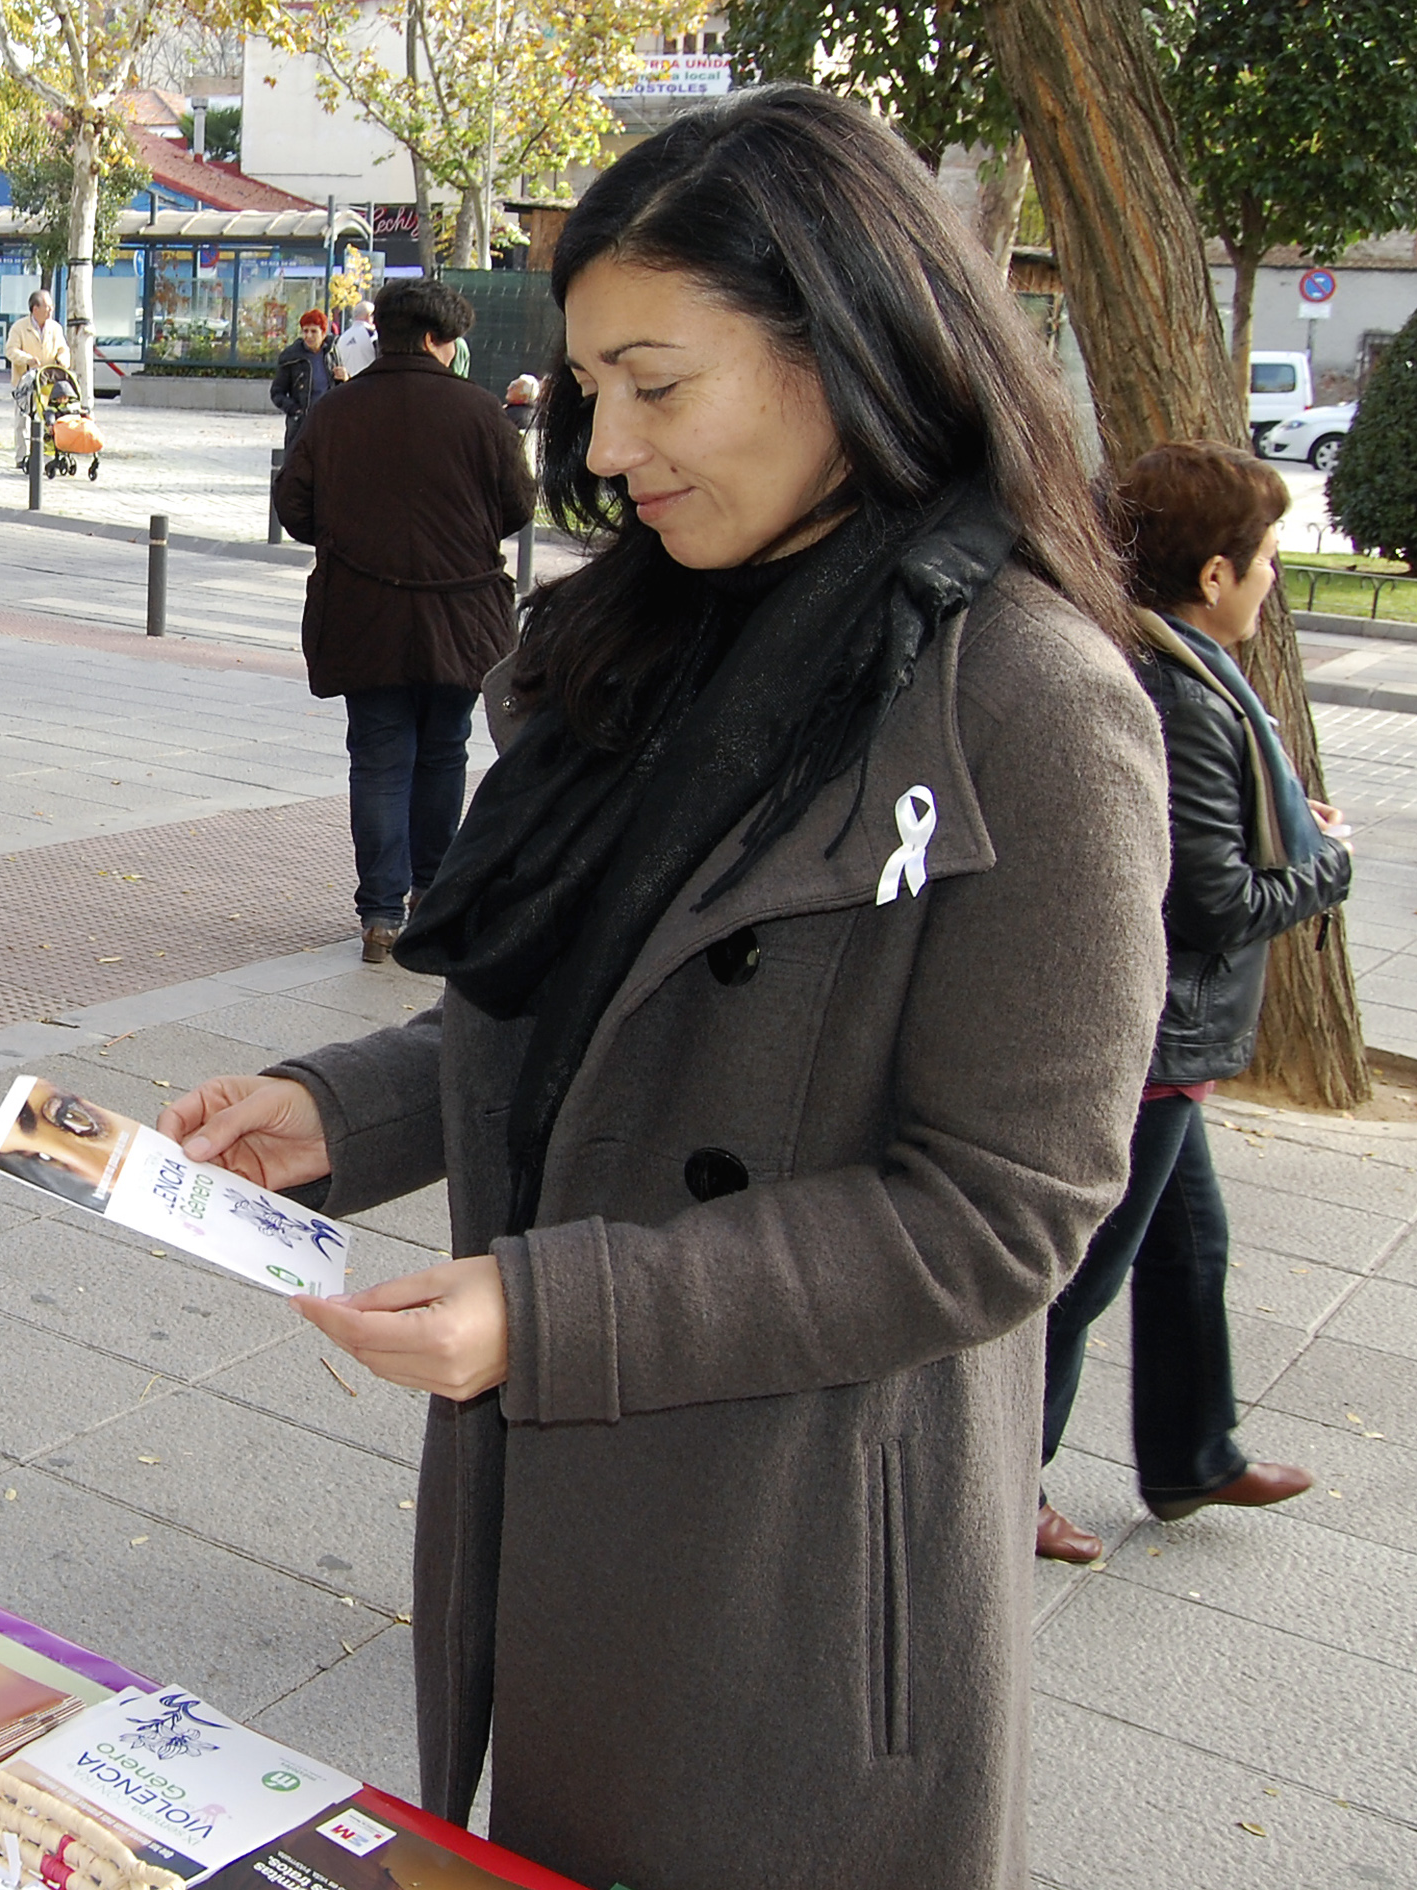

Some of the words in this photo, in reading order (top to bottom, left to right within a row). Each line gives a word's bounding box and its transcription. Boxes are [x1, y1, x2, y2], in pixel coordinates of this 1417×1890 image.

[684, 72, 720, 80] local
[180, 1173, 214, 1220] Género
[94, 1739, 186, 1804] Género
[76, 1750, 211, 1838] VIOLENCIA
[146, 1840, 162, 1852] los
[155, 1845, 175, 1858] Que
[268, 1855, 313, 1888] tratos.
